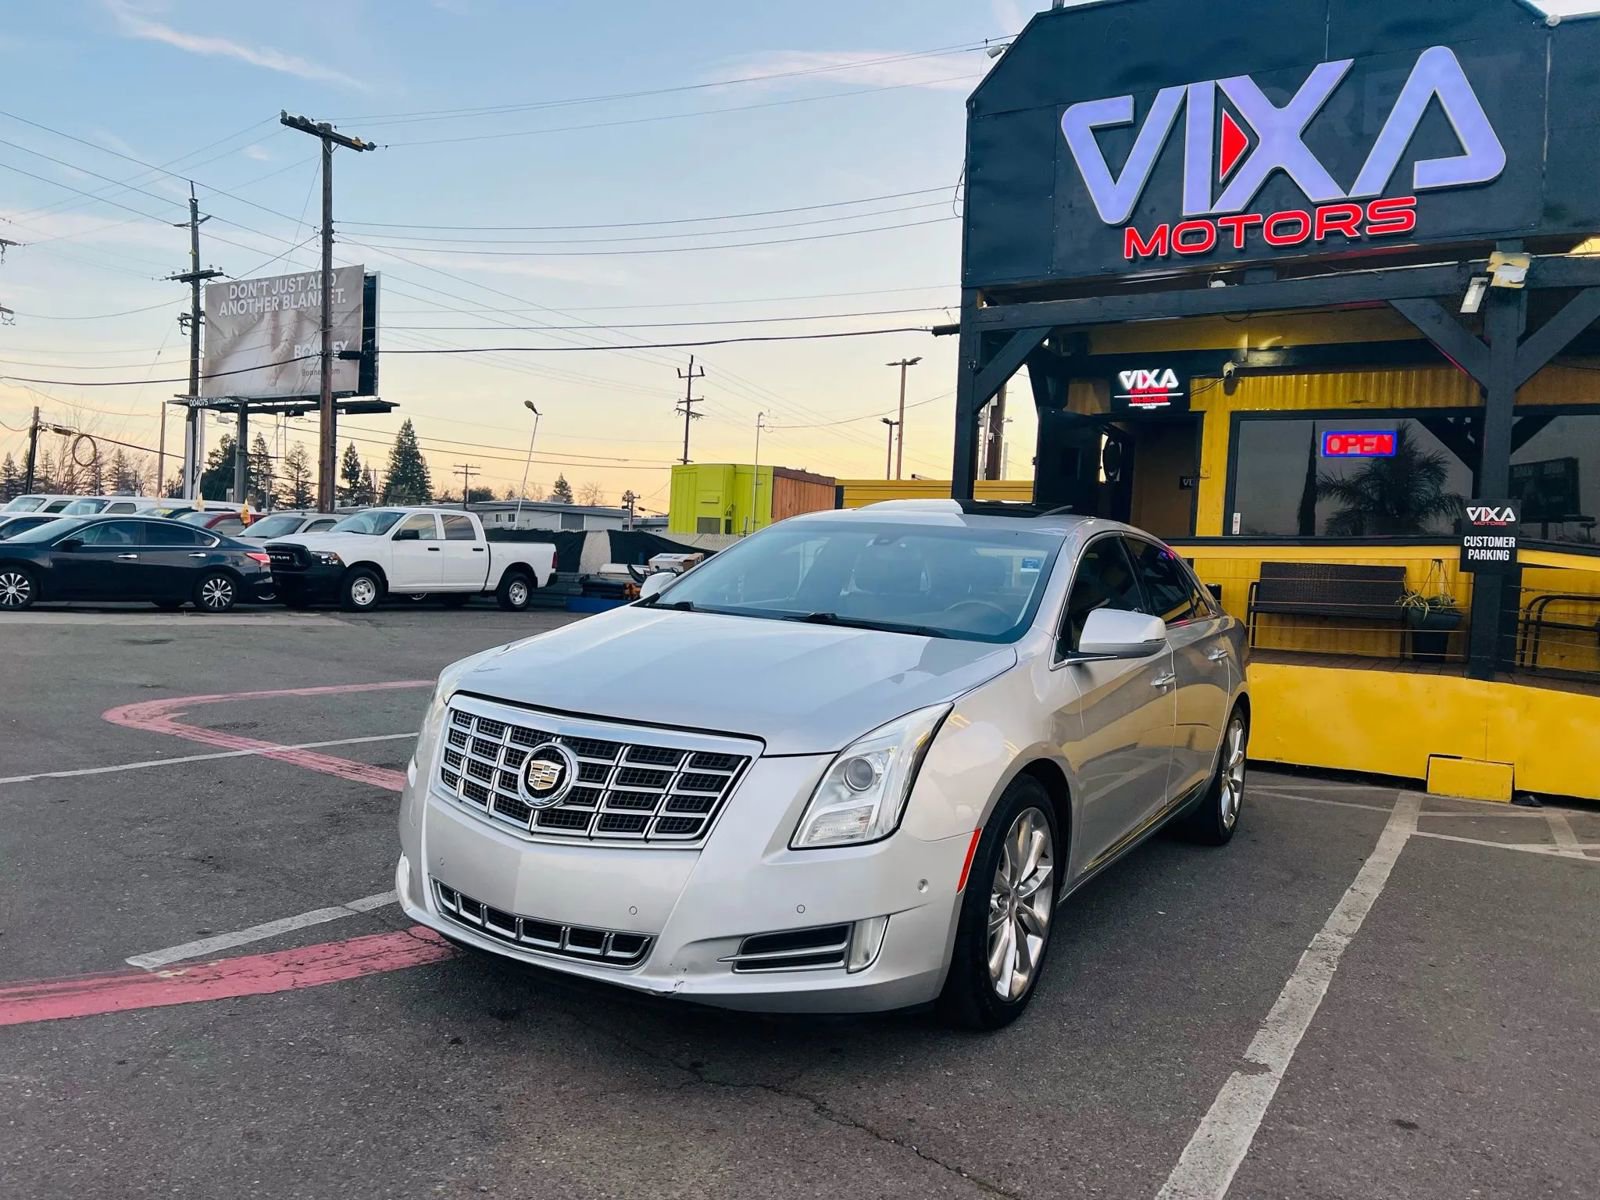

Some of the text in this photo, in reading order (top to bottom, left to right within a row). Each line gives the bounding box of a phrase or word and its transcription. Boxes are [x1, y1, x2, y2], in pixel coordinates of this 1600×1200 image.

[1061, 45, 1507, 225] VIXA
[1123, 196, 1418, 260] MOTORS
[229, 281, 270, 299] DON'T
[271, 276, 305, 295] JUST
[218, 288, 346, 317] ANOTHER BLANT.
[294, 340, 349, 359] BONEY
[1118, 368, 1179, 390] VIXA
[1326, 435, 1392, 453] OPEN
[1466, 506, 1516, 522] VIXA
[1463, 535, 1516, 548] CUSTOMER
[1468, 549, 1510, 561] PARKING
